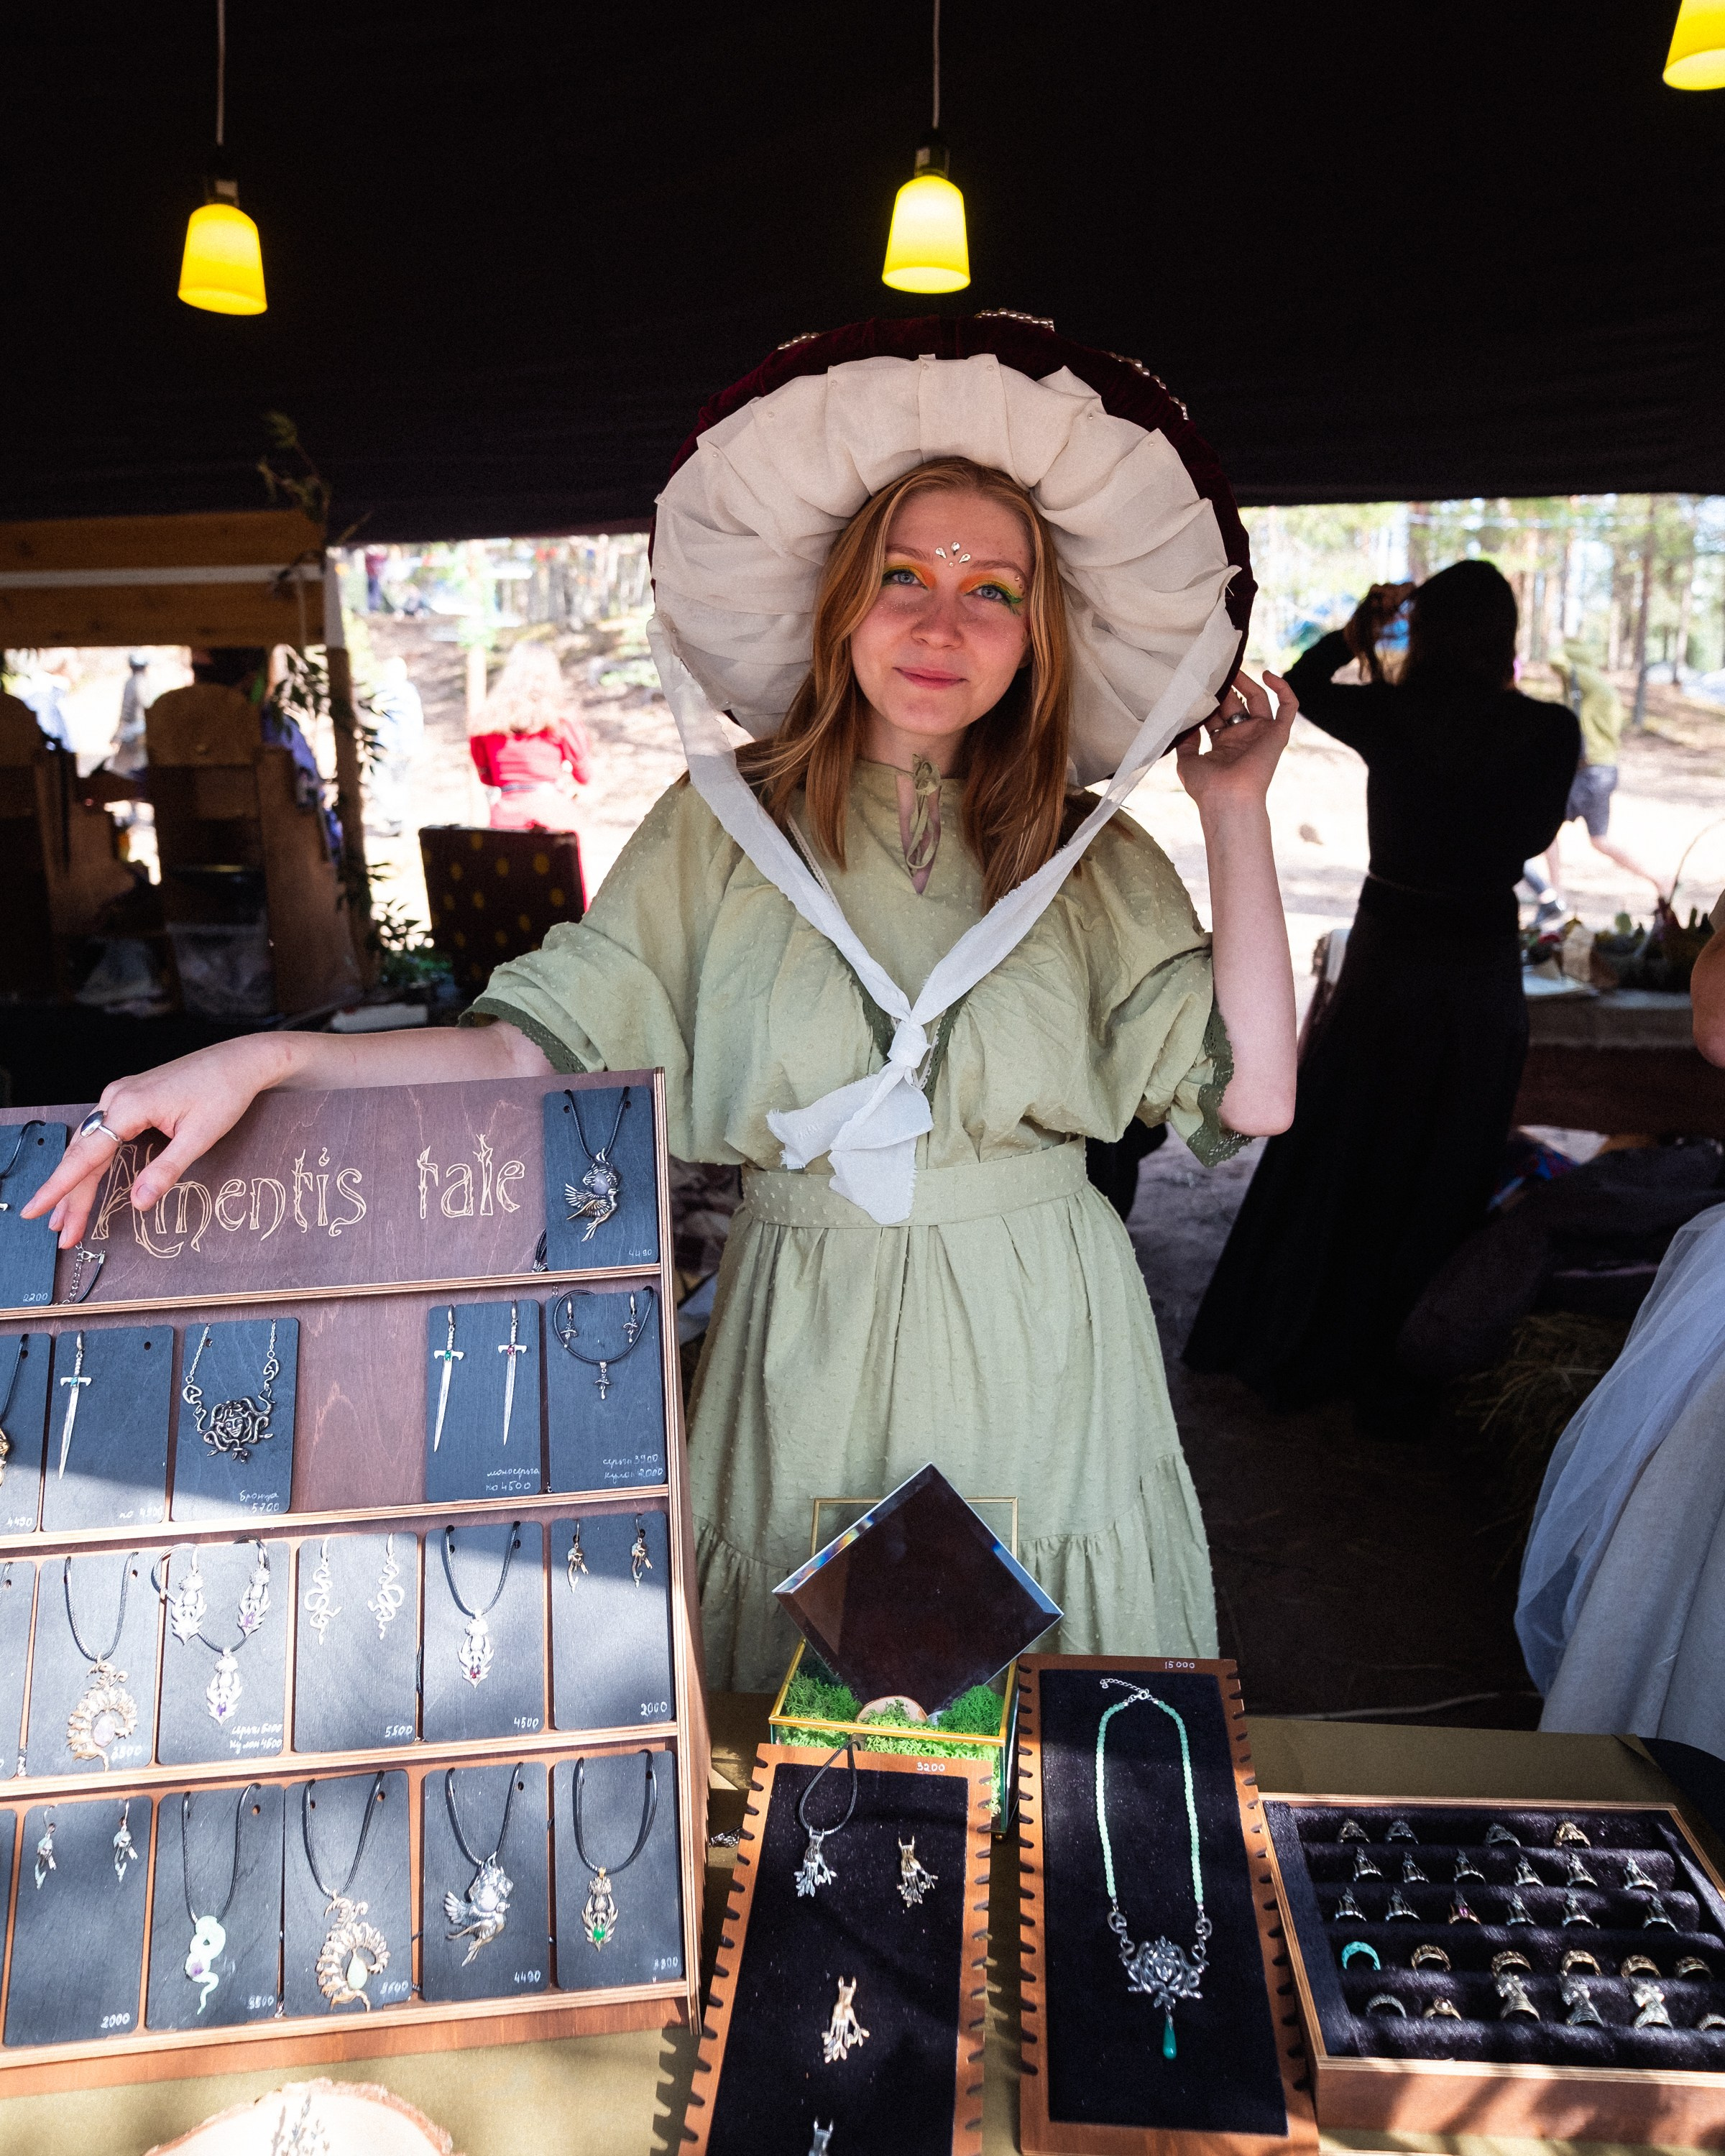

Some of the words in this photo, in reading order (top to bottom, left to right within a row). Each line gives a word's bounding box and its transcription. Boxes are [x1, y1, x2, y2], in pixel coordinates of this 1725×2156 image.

[628, 1248, 653, 1258] 4490
[22, 1292, 49, 1302] 2200
[501, 1480, 532, 1491] 4500
[252, 1502, 280, 1514] 5700
[640, 1700, 668, 1717] 2000
[513, 1716, 539, 1730] 4500
[916, 1761, 946, 1772] 3200
[100, 2012, 131, 2029] 2000
